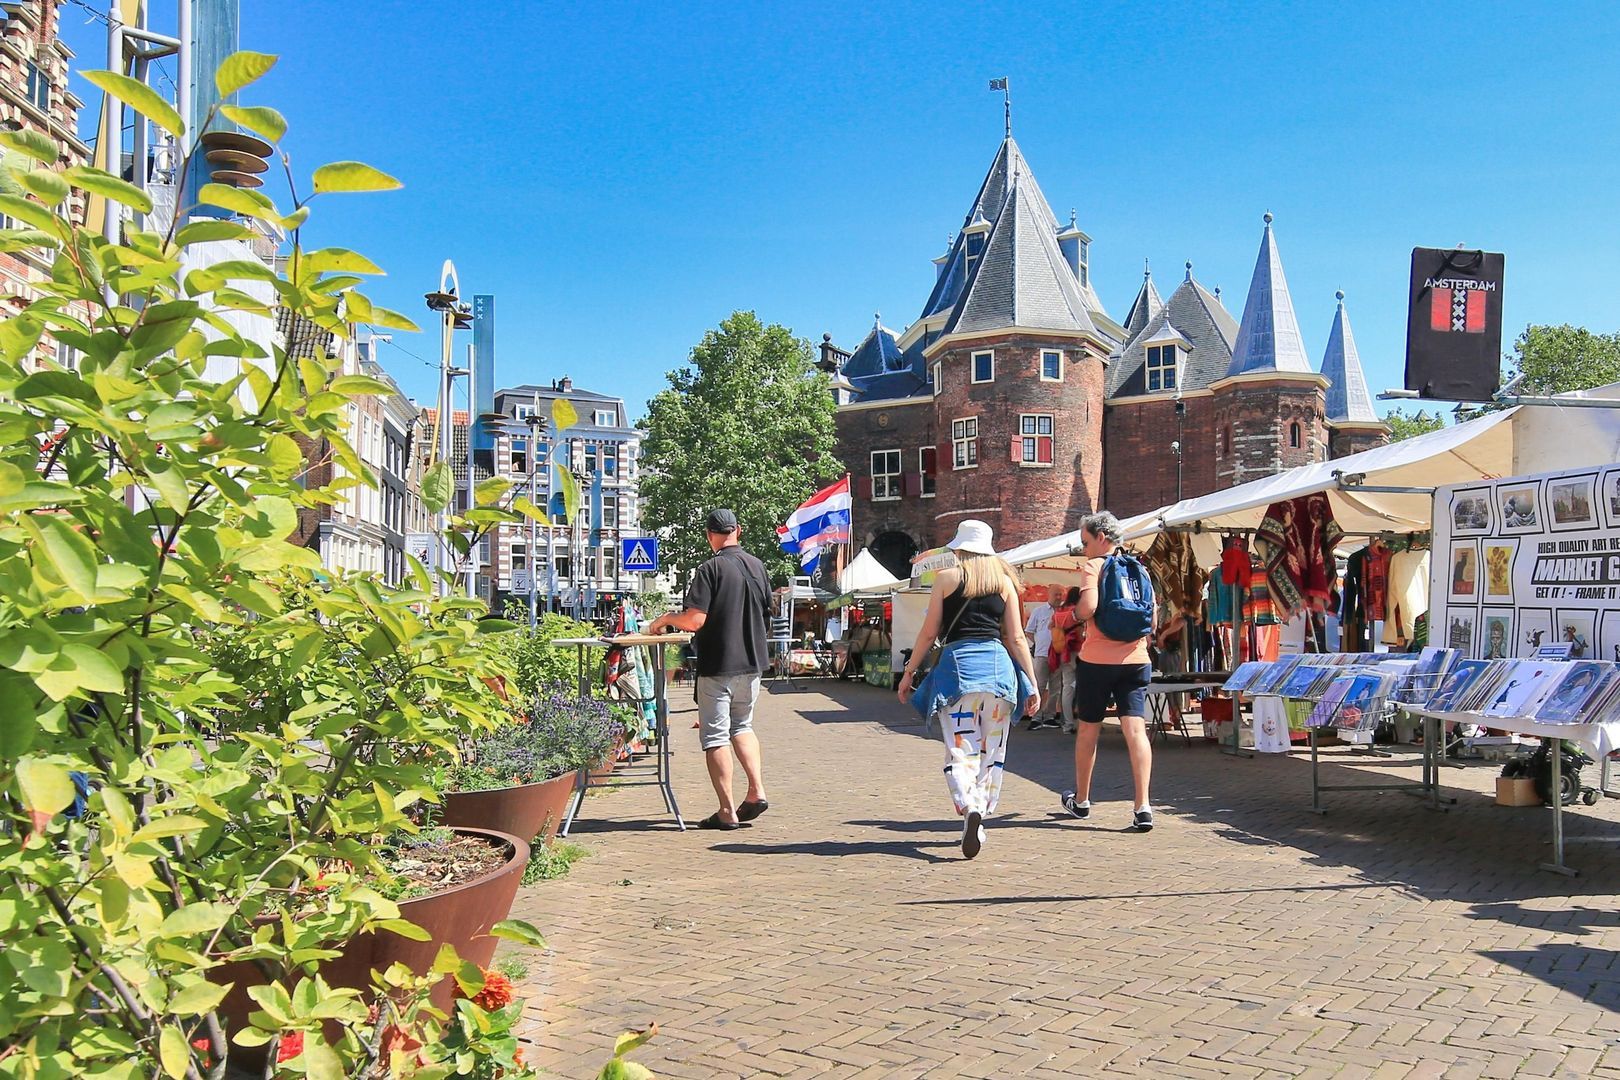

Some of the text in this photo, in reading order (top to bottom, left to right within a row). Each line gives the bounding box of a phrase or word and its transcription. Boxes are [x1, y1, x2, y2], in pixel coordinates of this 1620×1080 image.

[1424, 278, 1496, 291] AMSTERDAM
[1538, 542, 1556, 554] HIGH
[1559, 540, 1589, 552] QUALITY
[1592, 538, 1607, 551] ART
[1534, 557, 1603, 581] MARKET
[1536, 587, 1550, 598] GET
[1551, 587, 1561, 598] IT
[1575, 587, 1606, 599] FRAME
[1608, 587, 1616, 599] IT
